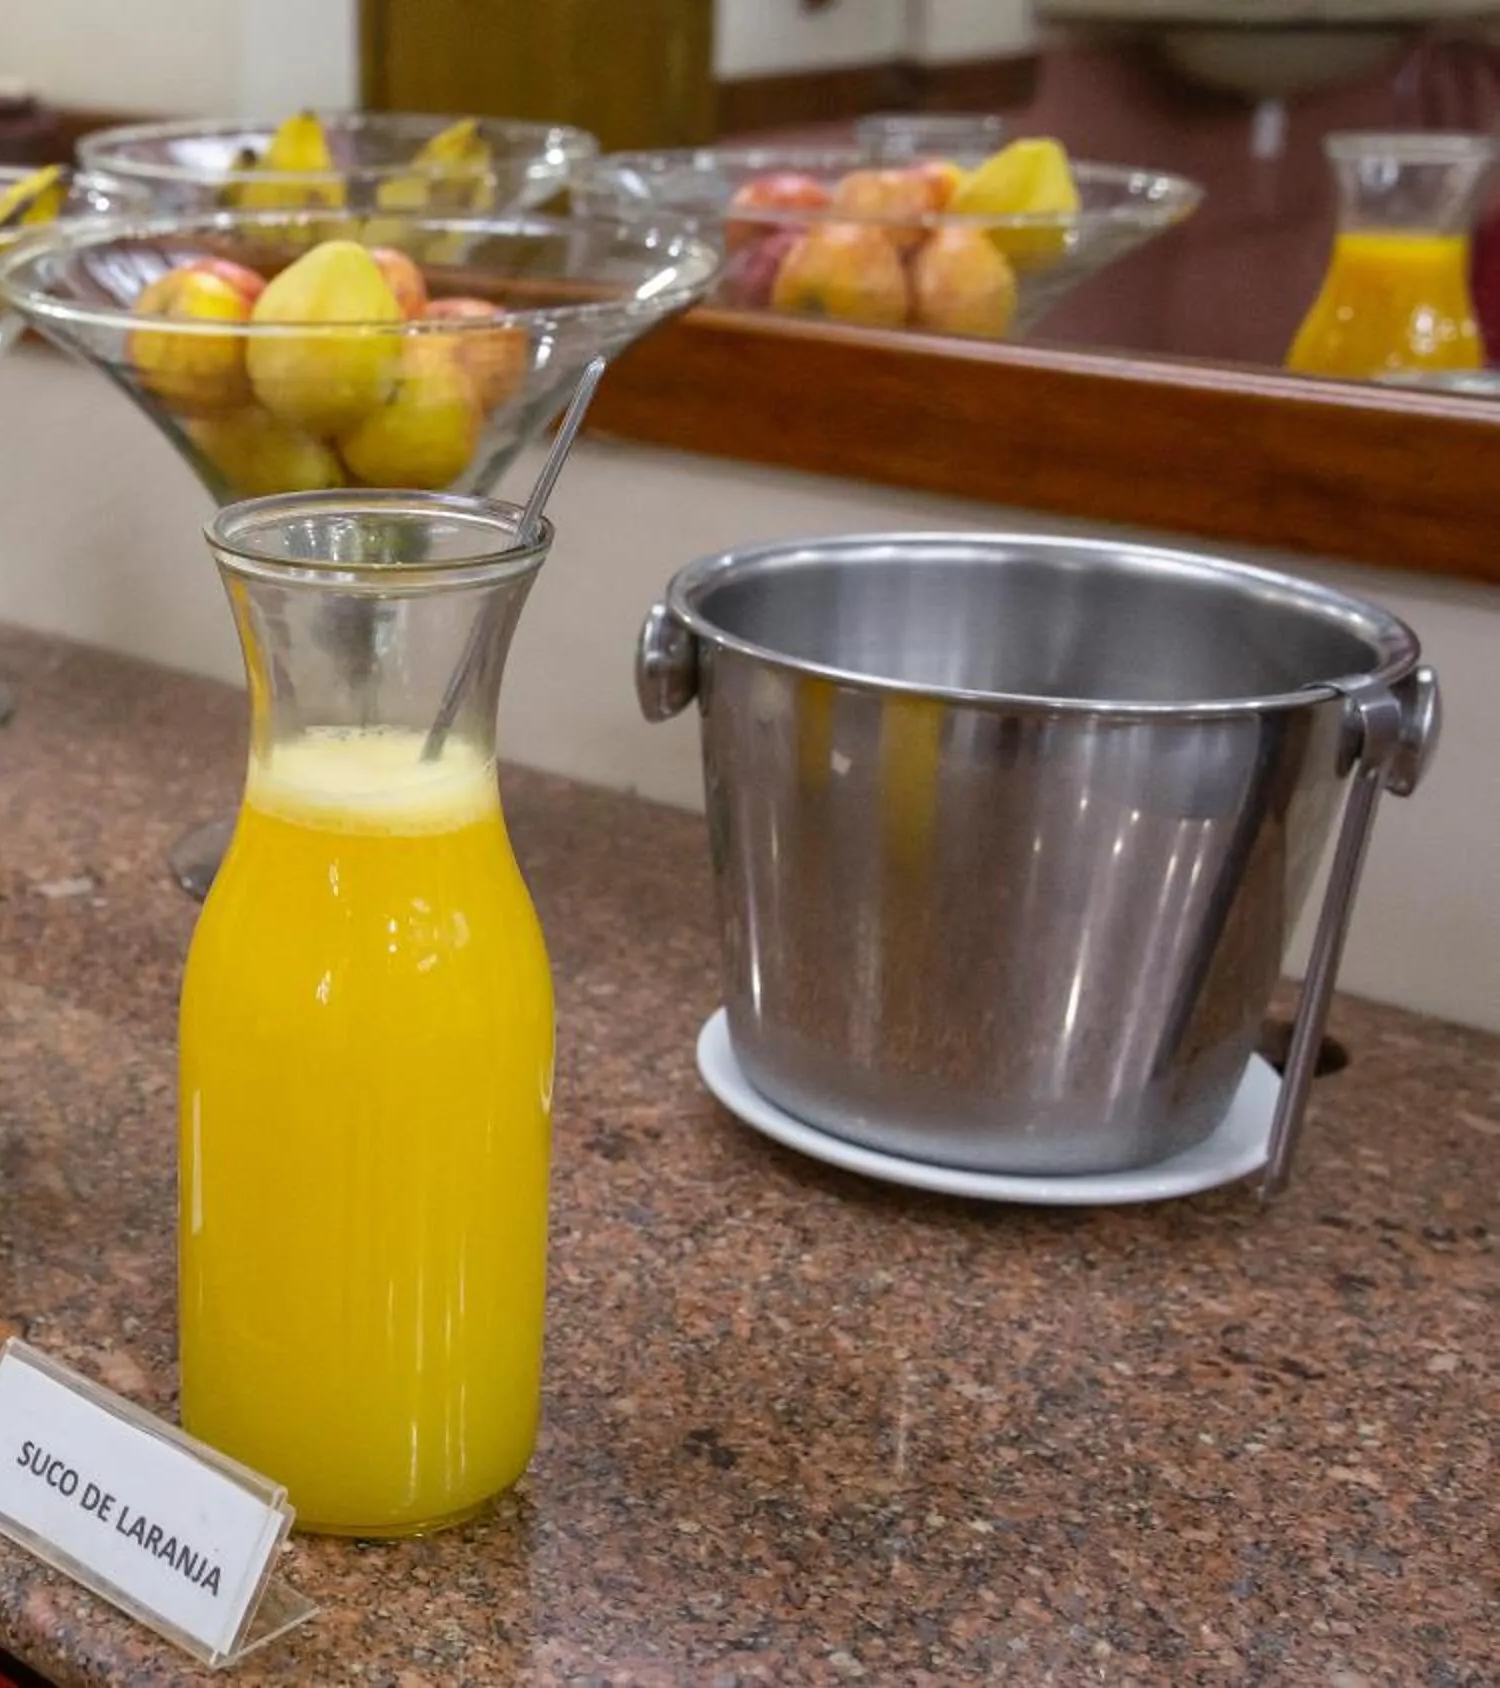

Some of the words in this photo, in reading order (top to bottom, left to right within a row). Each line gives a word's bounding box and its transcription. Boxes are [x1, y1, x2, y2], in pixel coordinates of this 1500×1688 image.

[16, 1440, 79, 1497] SUCO
[78, 1482, 117, 1522] DE
[115, 1505, 223, 1598] LARANJA
